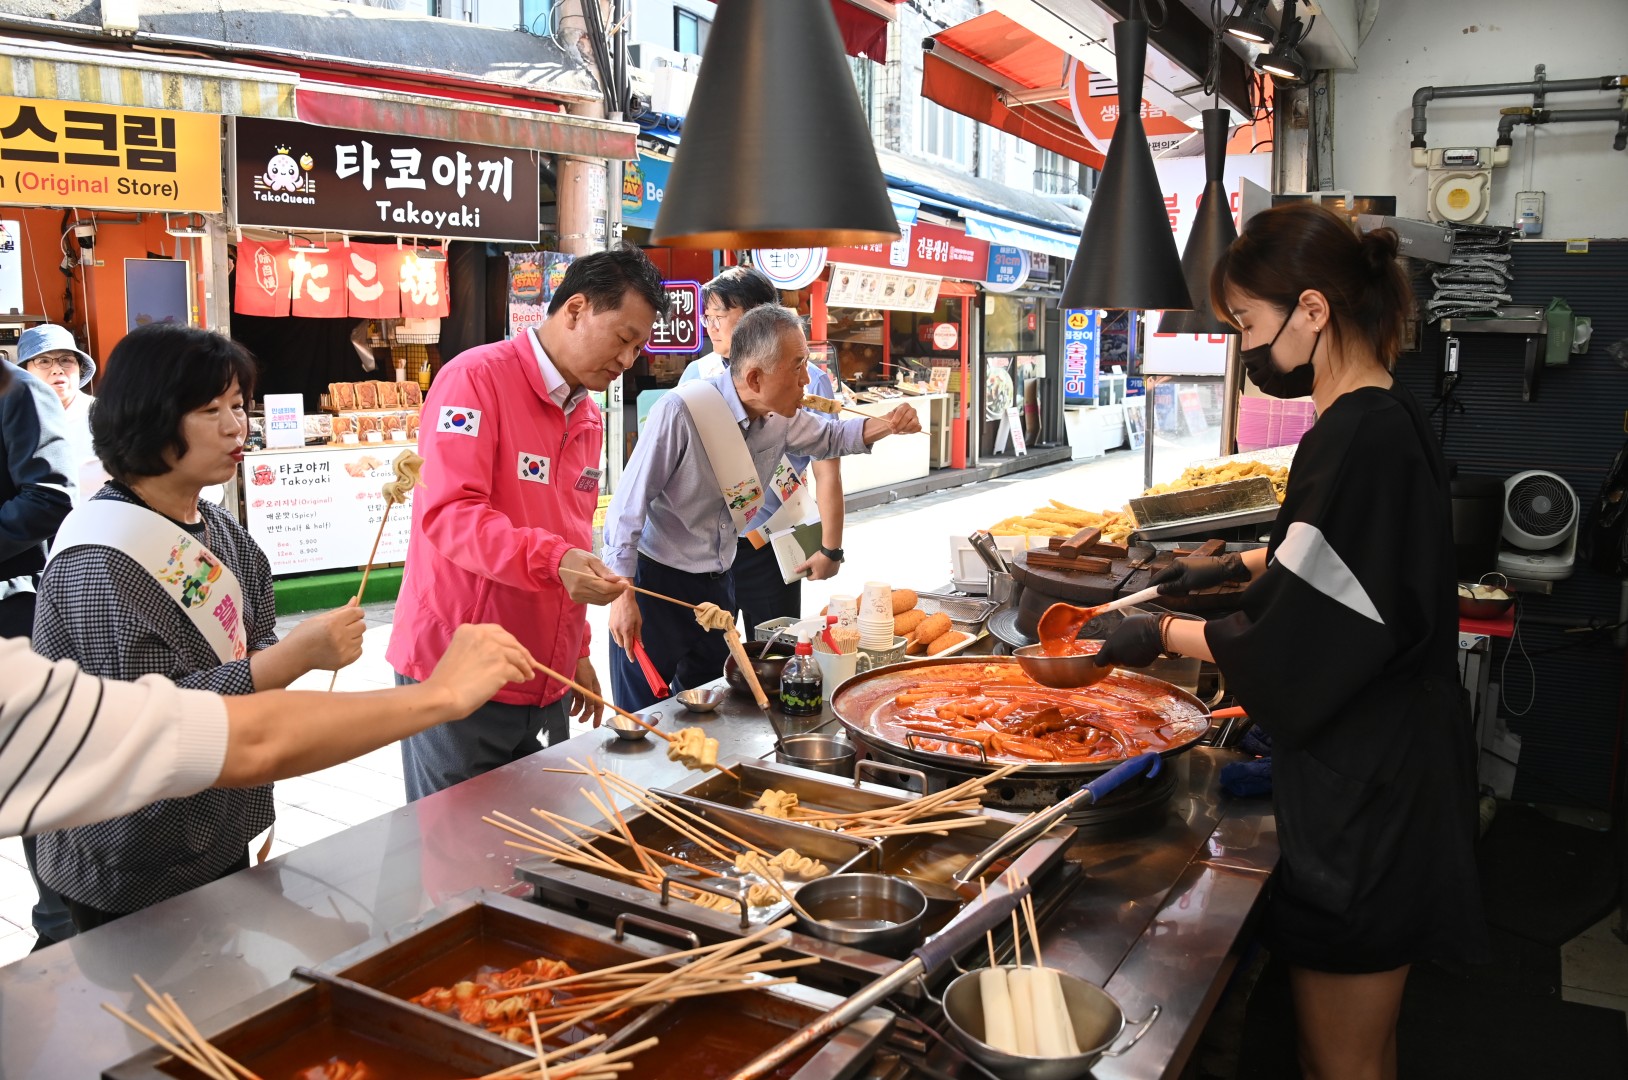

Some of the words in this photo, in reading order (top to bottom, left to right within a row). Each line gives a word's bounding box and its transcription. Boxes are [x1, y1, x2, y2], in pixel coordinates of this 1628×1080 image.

[335, 140, 514, 202] 타코야끼
[15, 171, 109, 196] (Original
[117, 177, 179, 201] Store)
[646, 181, 664, 203] Be
[253, 190, 315, 205] TakoQueen
[376, 200, 480, 230] Takoyaki
[512, 312, 542, 323] Beach
[1071, 316, 1085, 328] 산
[279, 461, 330, 475] 타코야끼
[281, 475, 331, 487] Takoyaki
